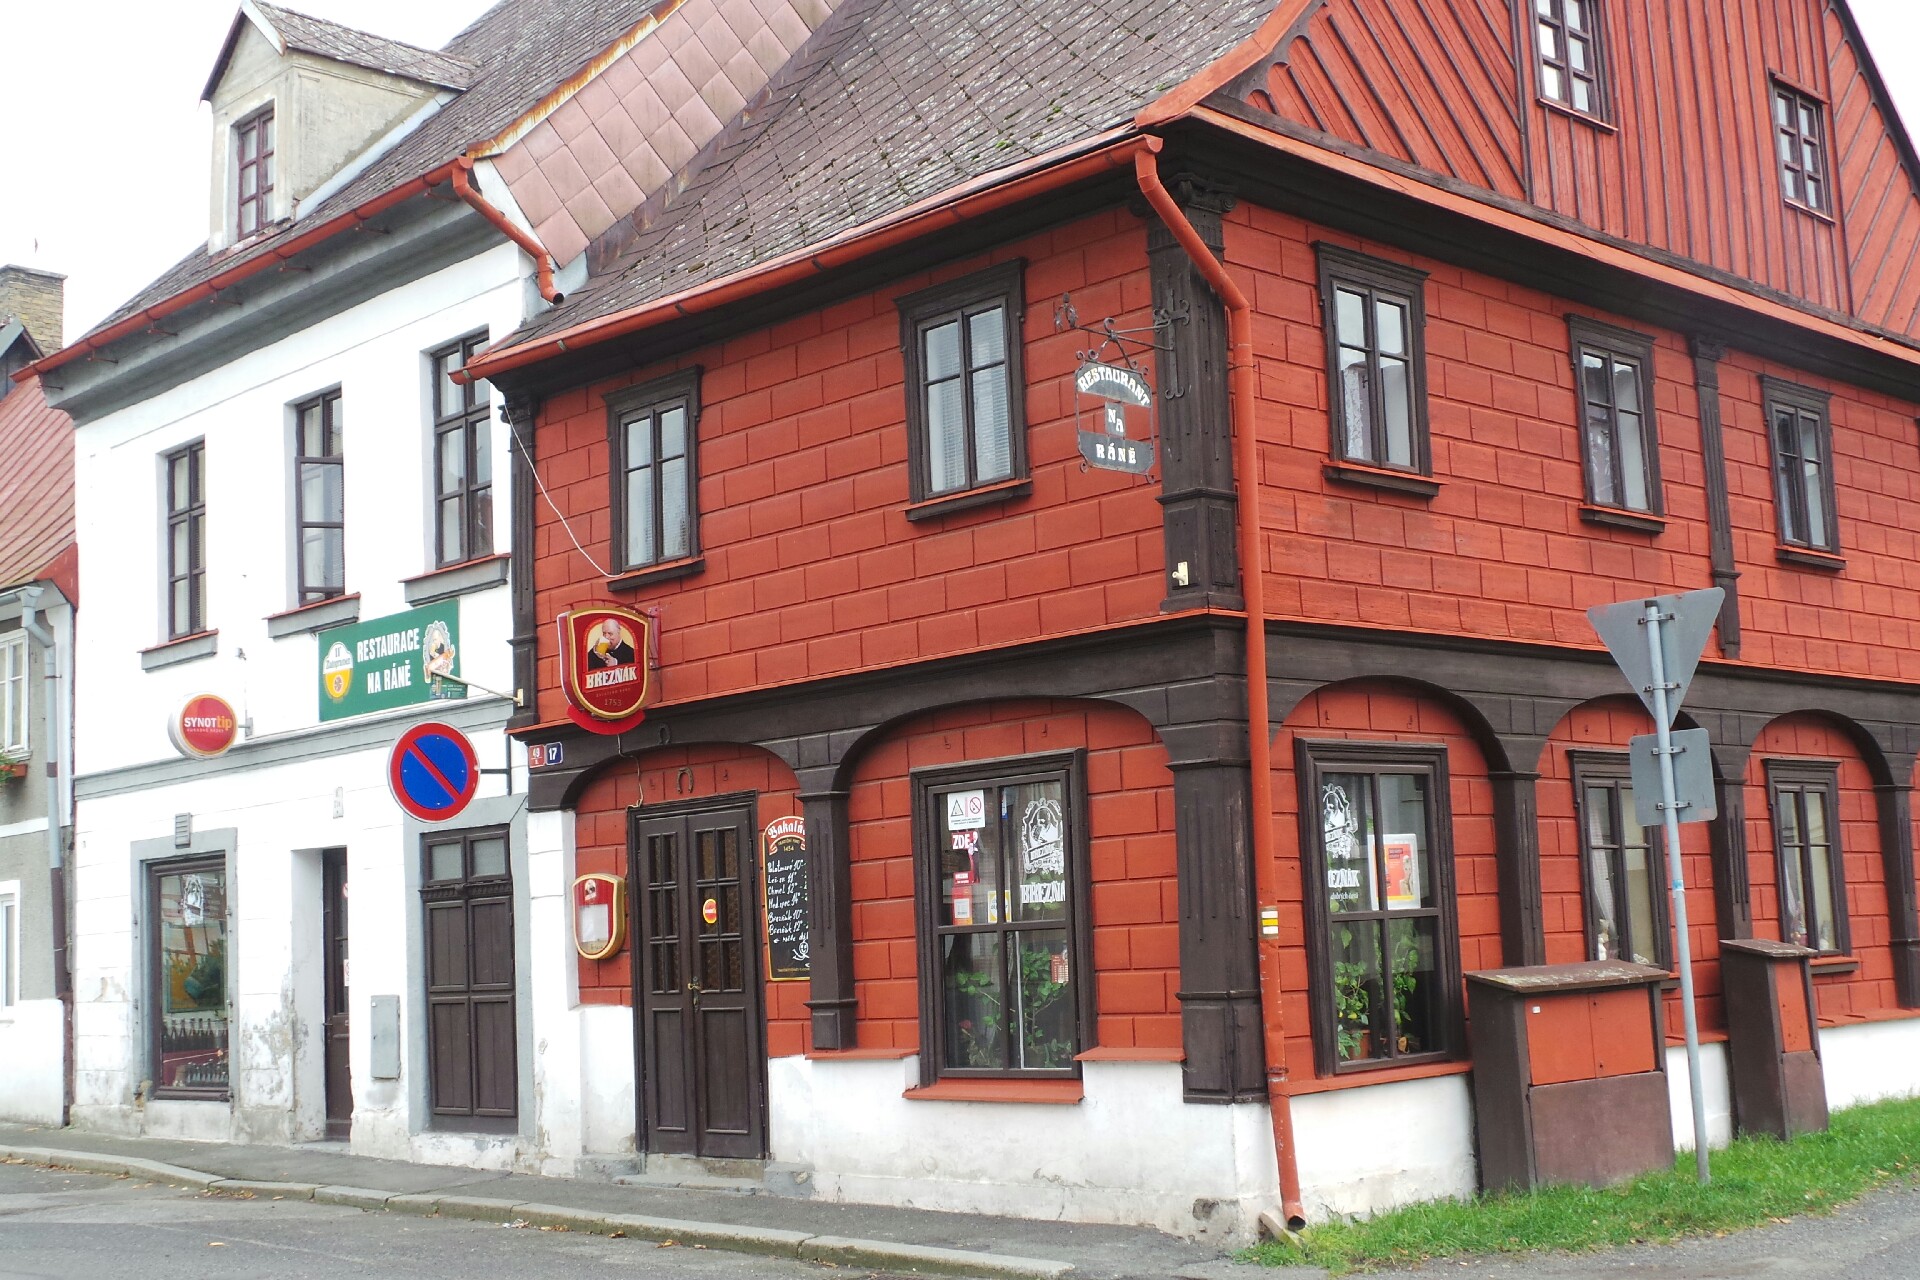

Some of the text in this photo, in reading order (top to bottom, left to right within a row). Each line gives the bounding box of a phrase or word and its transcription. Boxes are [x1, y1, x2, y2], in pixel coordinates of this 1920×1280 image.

[1077, 366, 1150, 406] RESTAURANT
[1107, 408, 1124, 433] NA
[1095, 442, 1137, 464] RÁNĚ
[357, 627, 420, 663] RESTAURACE
[367, 659, 412, 694] NA RÁNĚ
[585, 667, 637, 689] BŘEZŇÁK
[604, 698, 622, 706] 1753
[548, 747, 557, 761] 17
[952, 834, 971, 850] ZDE
